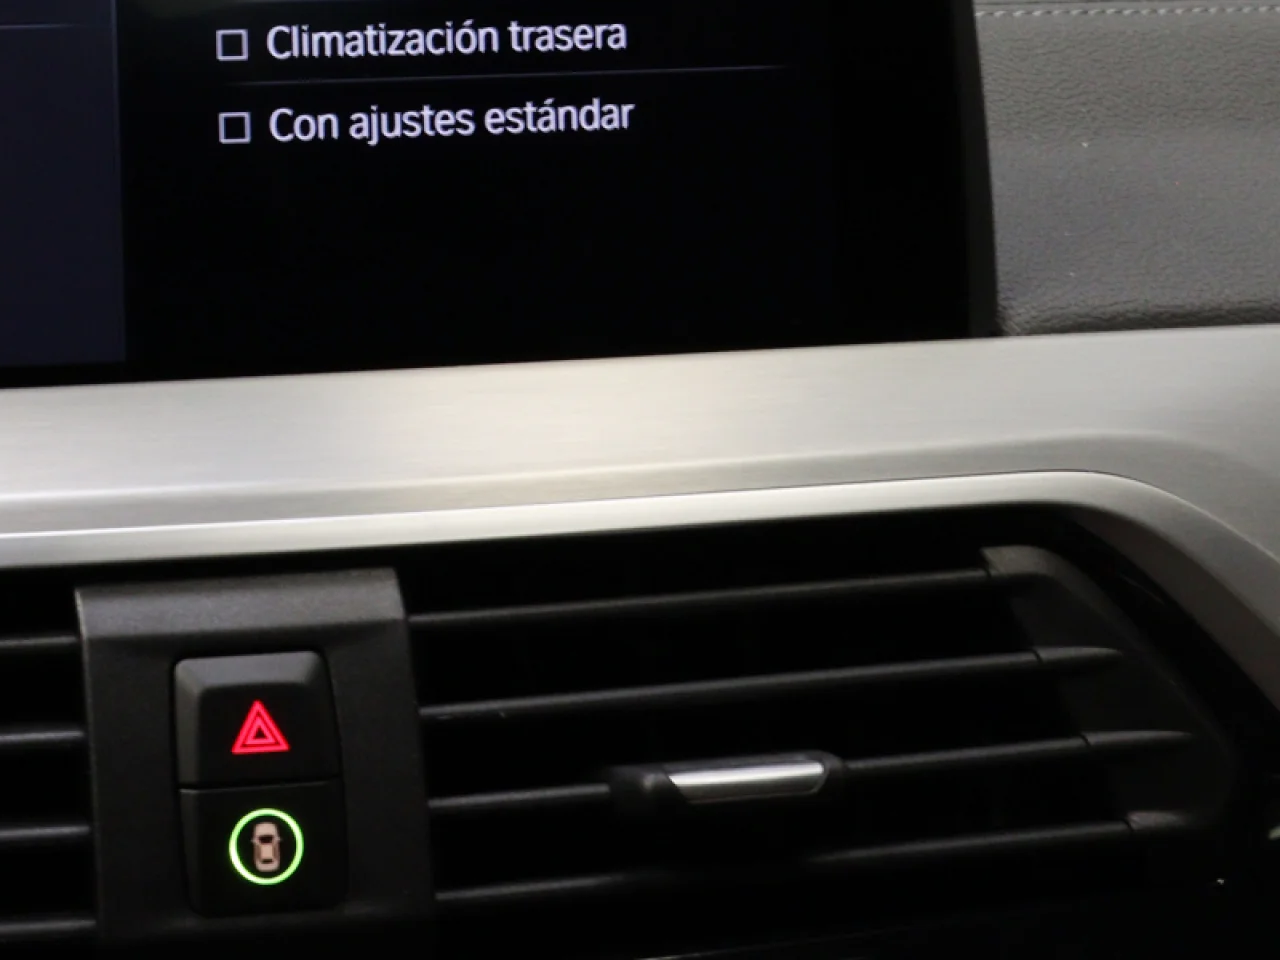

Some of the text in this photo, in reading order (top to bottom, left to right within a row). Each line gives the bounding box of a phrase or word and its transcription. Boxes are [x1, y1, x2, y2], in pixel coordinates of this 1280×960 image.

[267, 18, 627, 60] Climatización trasera
[269, 97, 636, 147] Con ajustes estándar
